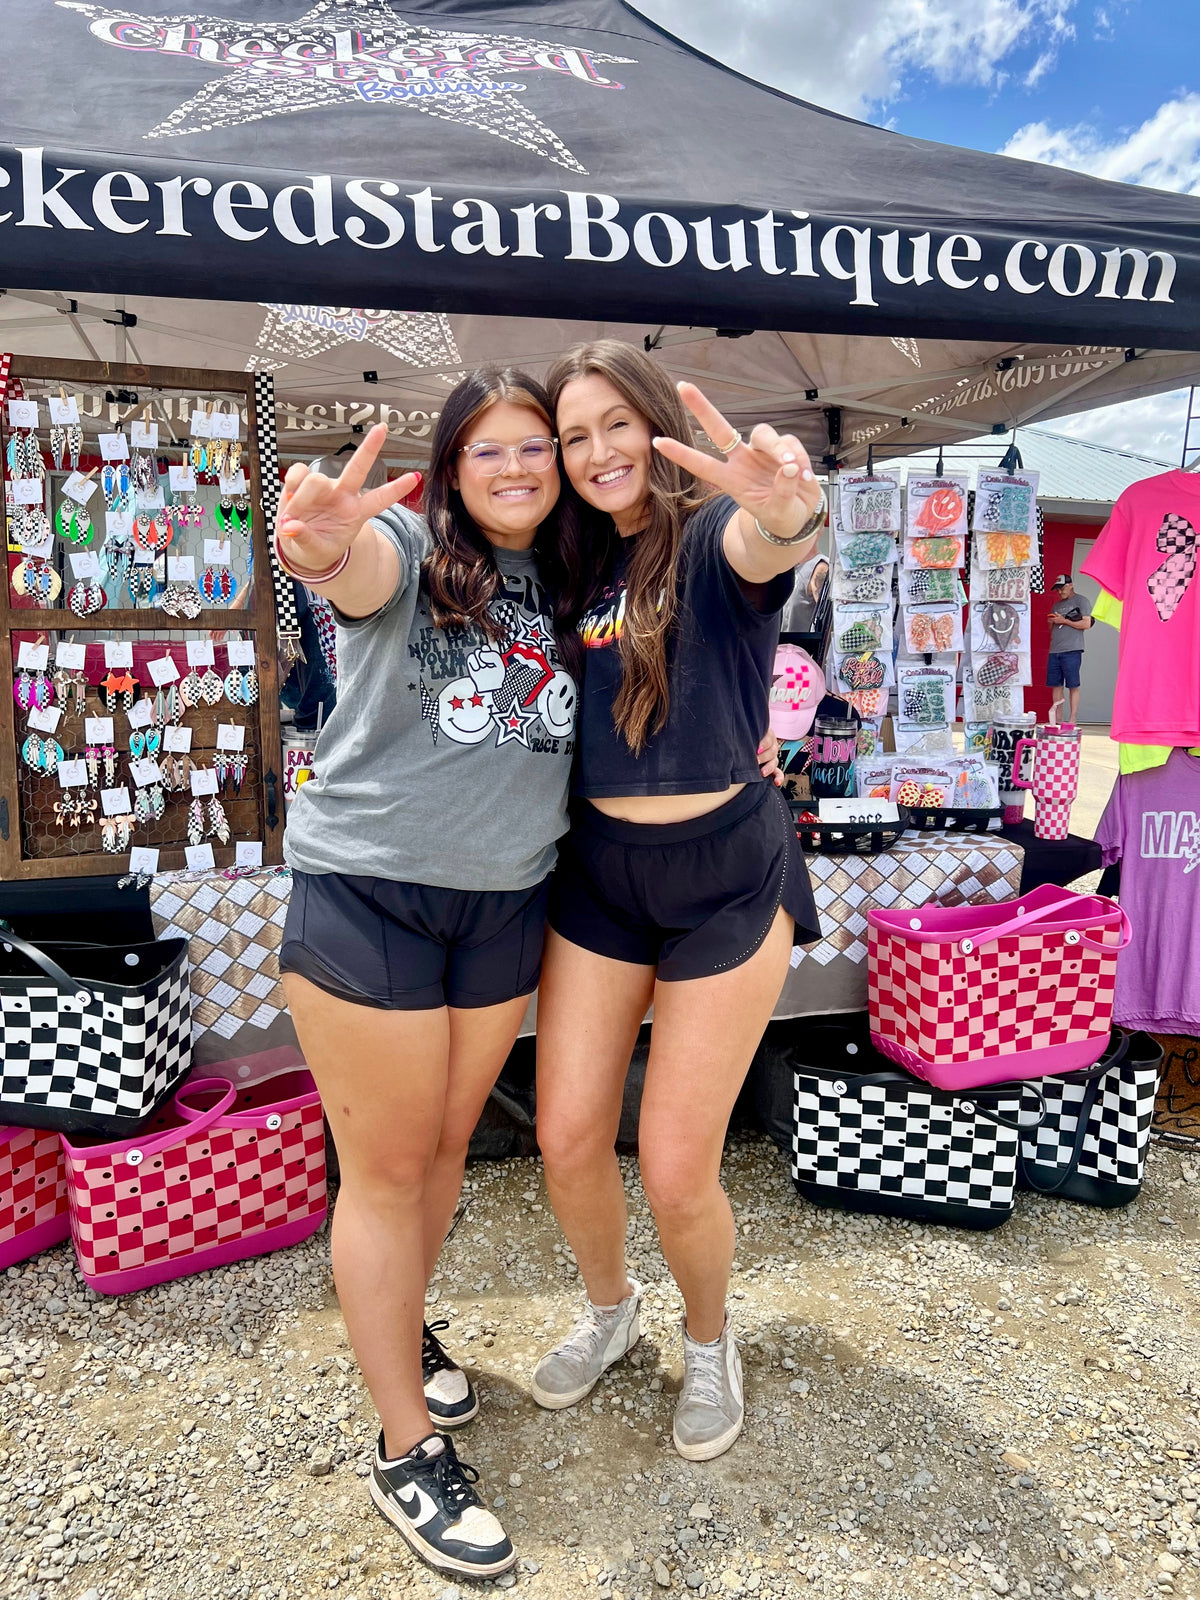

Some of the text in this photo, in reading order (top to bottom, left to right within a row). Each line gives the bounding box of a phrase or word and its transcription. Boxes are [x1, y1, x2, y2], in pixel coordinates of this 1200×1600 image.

[87, 16, 625, 89] Checkered
[357, 77, 527, 102] Boutique
[988, 579, 1025, 599] WIFE
[419, 626, 434, 641] IF
[408, 637, 440, 658] NOT
[841, 657, 879, 674] Raise
[852, 669, 884, 689] Hell
[530, 738, 559, 754] RACE
[287, 751, 314, 766] RAC
